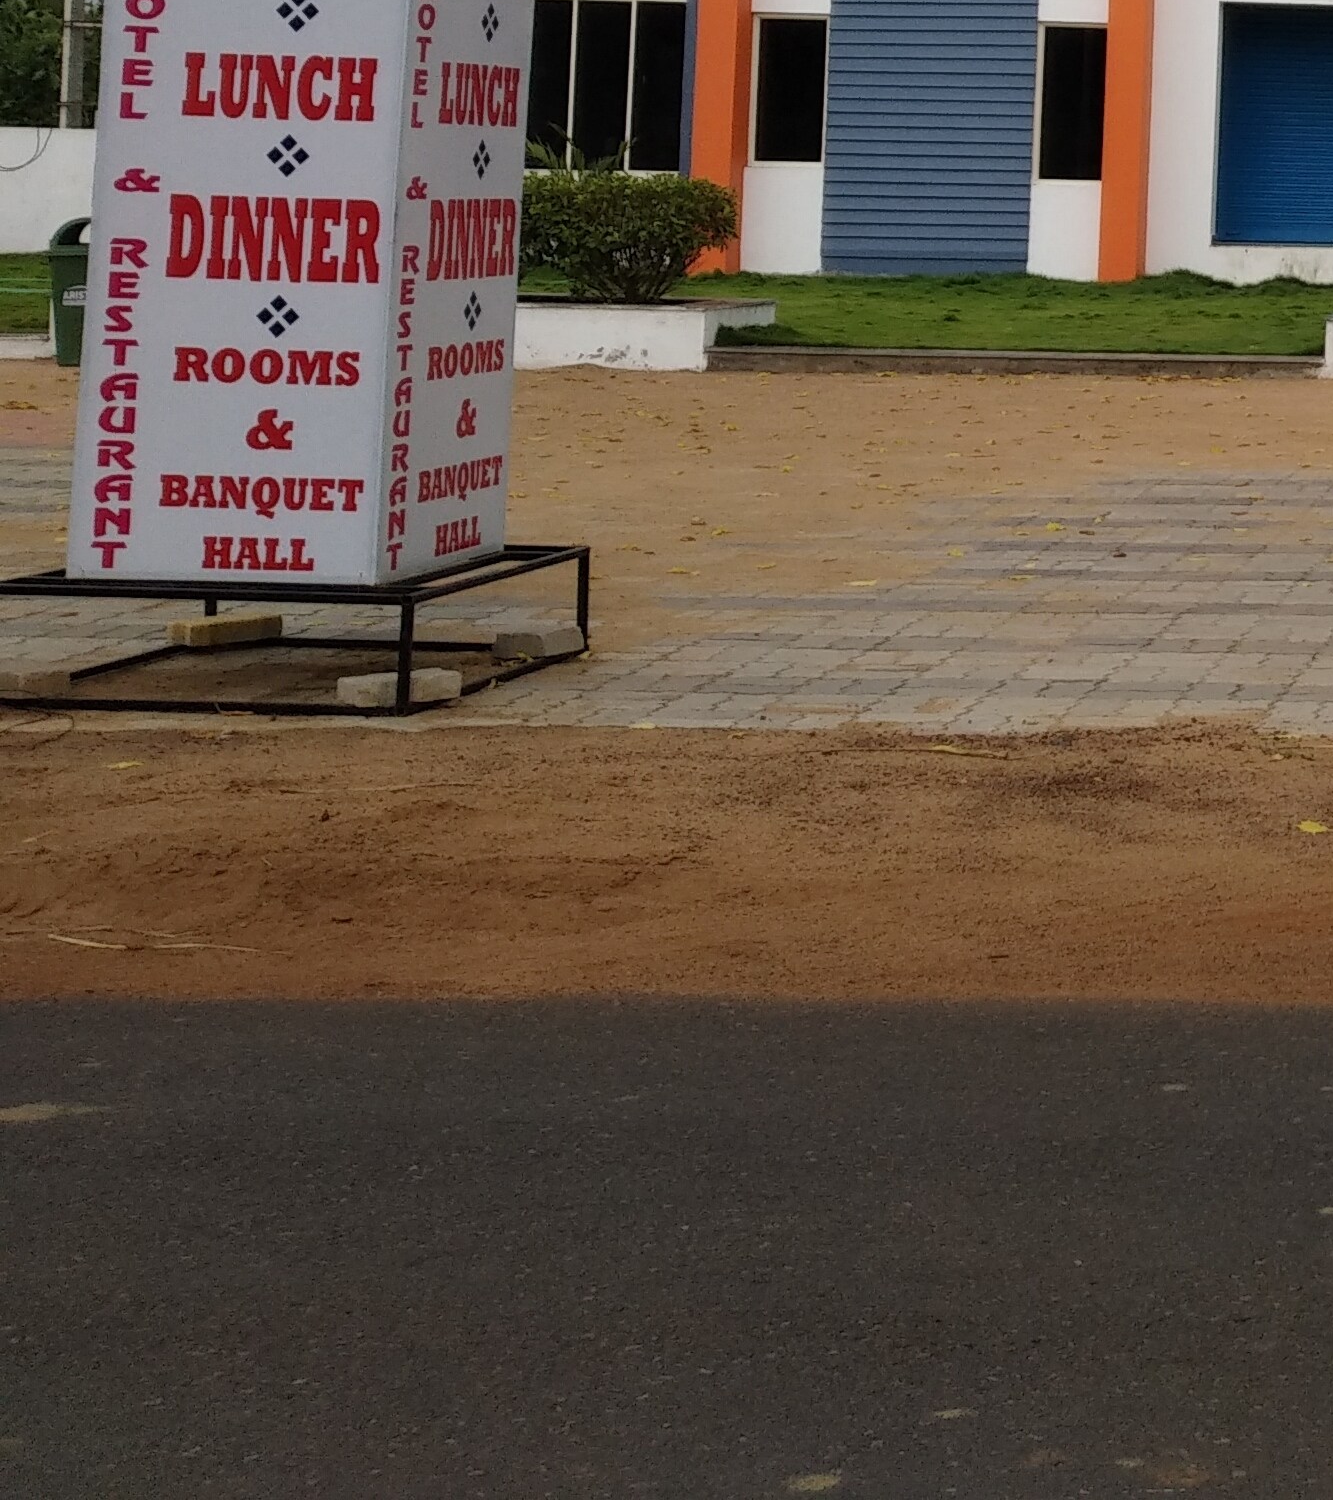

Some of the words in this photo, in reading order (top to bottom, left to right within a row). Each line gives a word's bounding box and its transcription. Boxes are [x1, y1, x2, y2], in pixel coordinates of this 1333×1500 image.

[181, 52, 379, 123] LUNCH
[438, 62, 520, 127] LUNCH
[115, 167, 160, 193] &
[165, 193, 381, 284] DINNER
[425, 198, 516, 282] DINNER
[174, 346, 361, 386] ROOMS
[427, 339, 505, 380] ROOMS
[92, 238, 148, 569] RESTAURANT
[386, 245, 420, 571] RESTAURANT
[456, 399, 477, 438] &
[246, 408, 294, 451] &
[160, 474, 364, 519] BANQUET
[417, 456, 504, 503] BANQUET
[202, 536, 315, 572] HALL
[434, 516, 481, 556] HALL
